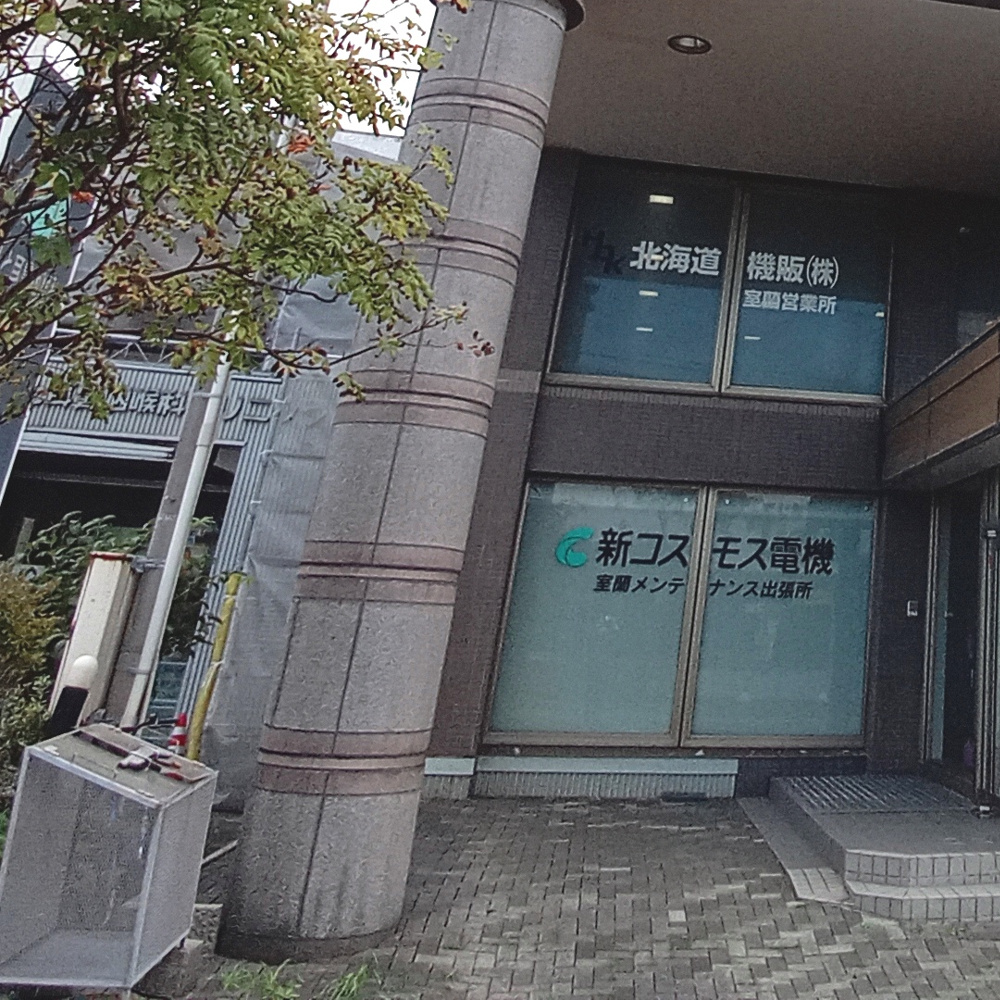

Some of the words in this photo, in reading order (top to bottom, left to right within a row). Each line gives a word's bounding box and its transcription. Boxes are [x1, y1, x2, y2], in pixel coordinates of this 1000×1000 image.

[596, 528, 835, 575] 新コスモス電機
